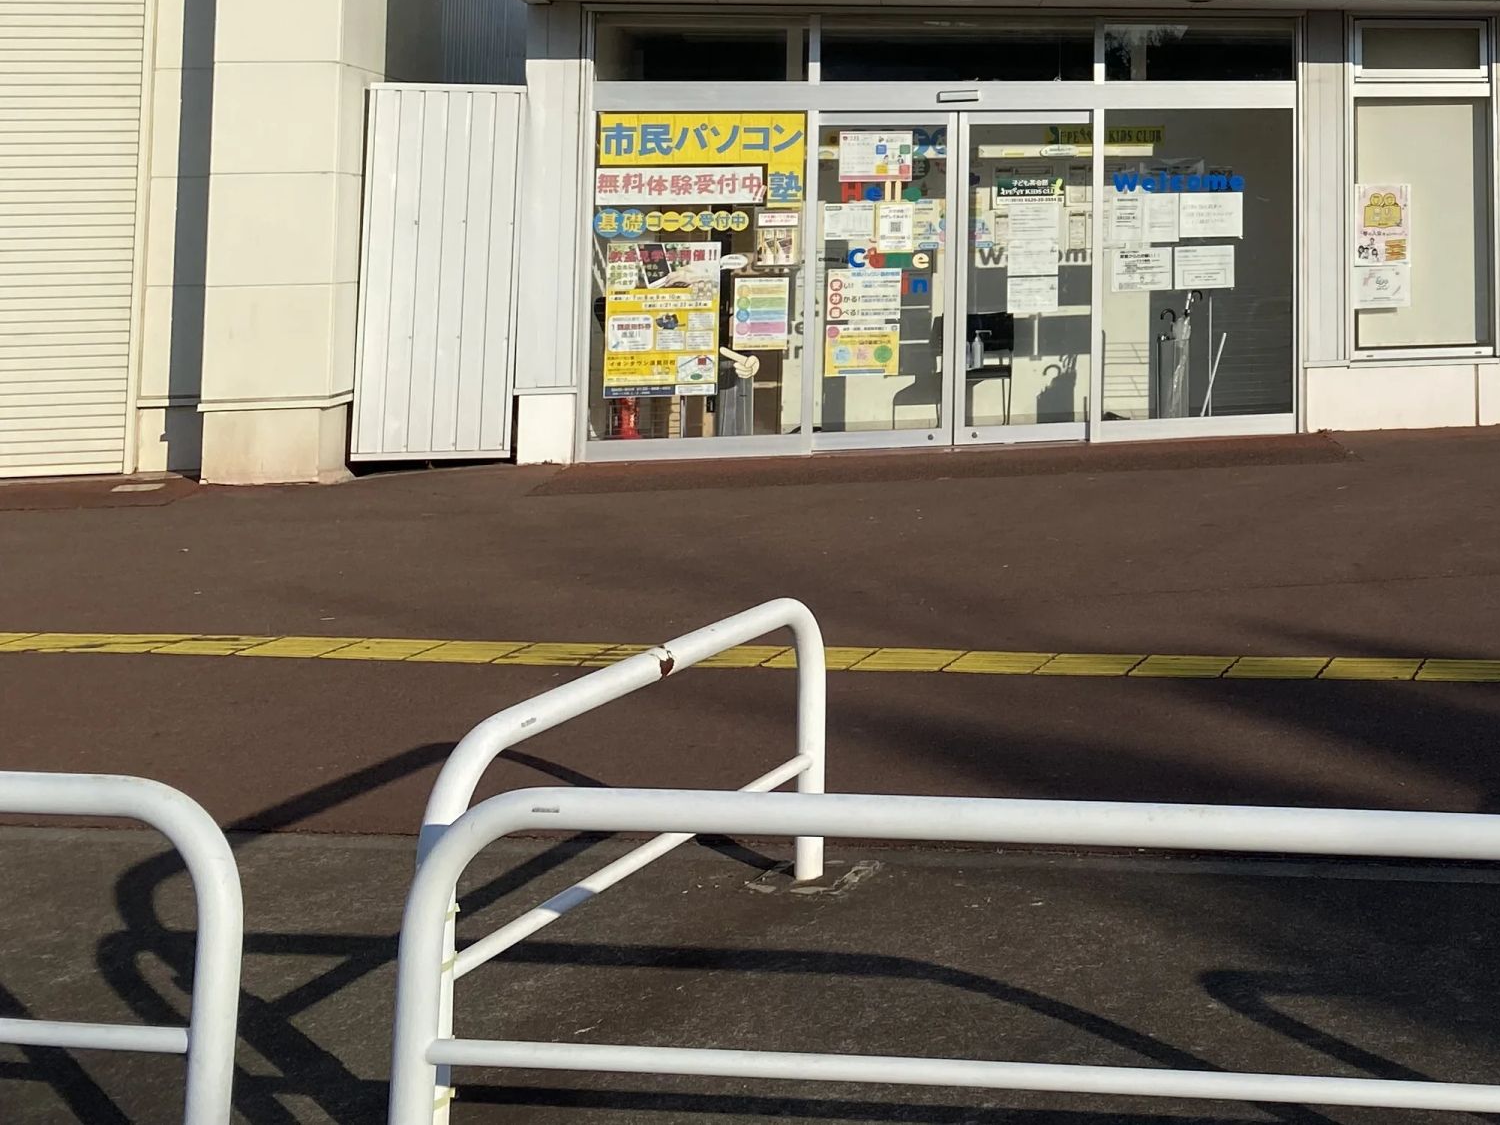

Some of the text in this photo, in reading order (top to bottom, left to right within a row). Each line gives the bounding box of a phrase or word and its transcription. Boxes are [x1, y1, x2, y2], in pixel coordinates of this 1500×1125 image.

[602, 123, 803, 157] 市民パソコン
[597, 172, 767, 203] 無料体験受付中!!
[768, 171, 802, 203] 塾
[841, 180, 923, 203] Hello
[1112, 170, 1246, 192] Welcome
[597, 209, 747, 233] 基礎コース受付中
